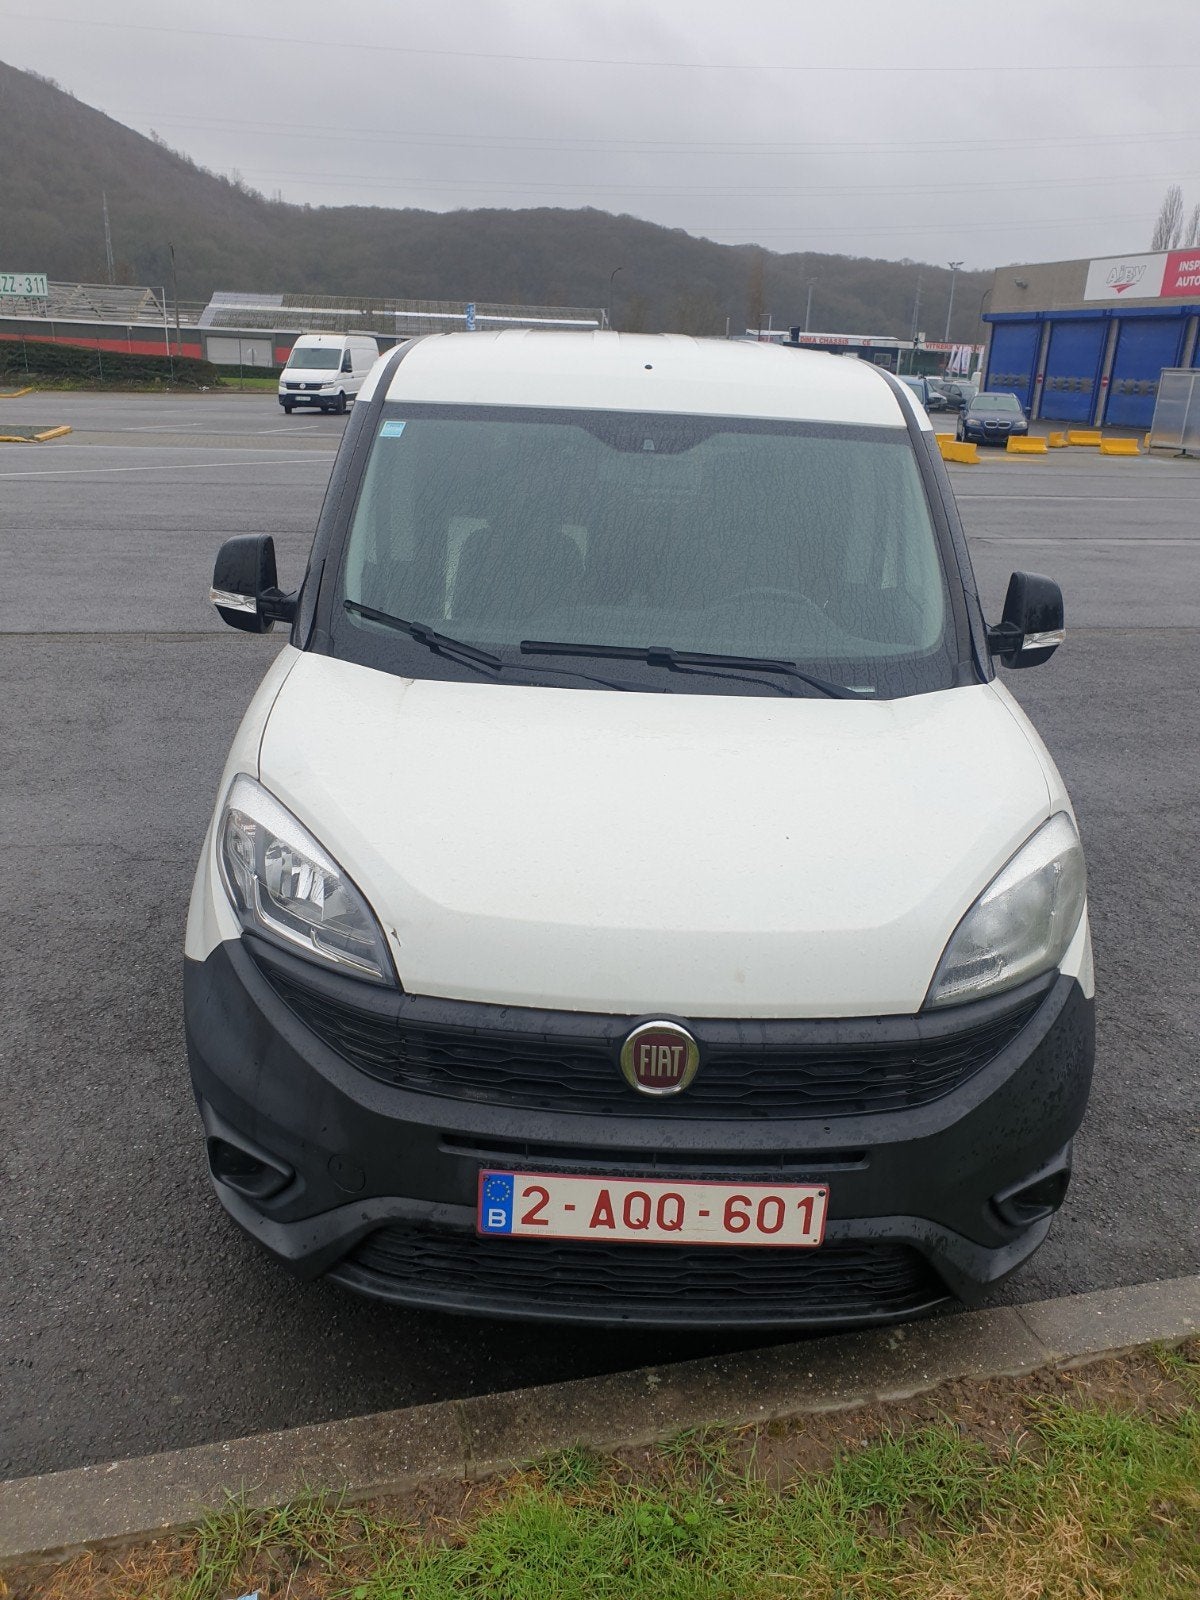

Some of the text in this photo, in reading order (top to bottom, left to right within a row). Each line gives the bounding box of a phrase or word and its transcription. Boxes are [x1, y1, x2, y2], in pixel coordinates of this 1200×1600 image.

[1178, 260, 1200, 271] INSP
[0, 276, 45, 294] ZZ-311
[640, 1044, 684, 1077] FIAT
[487, 1208, 507, 1228] B
